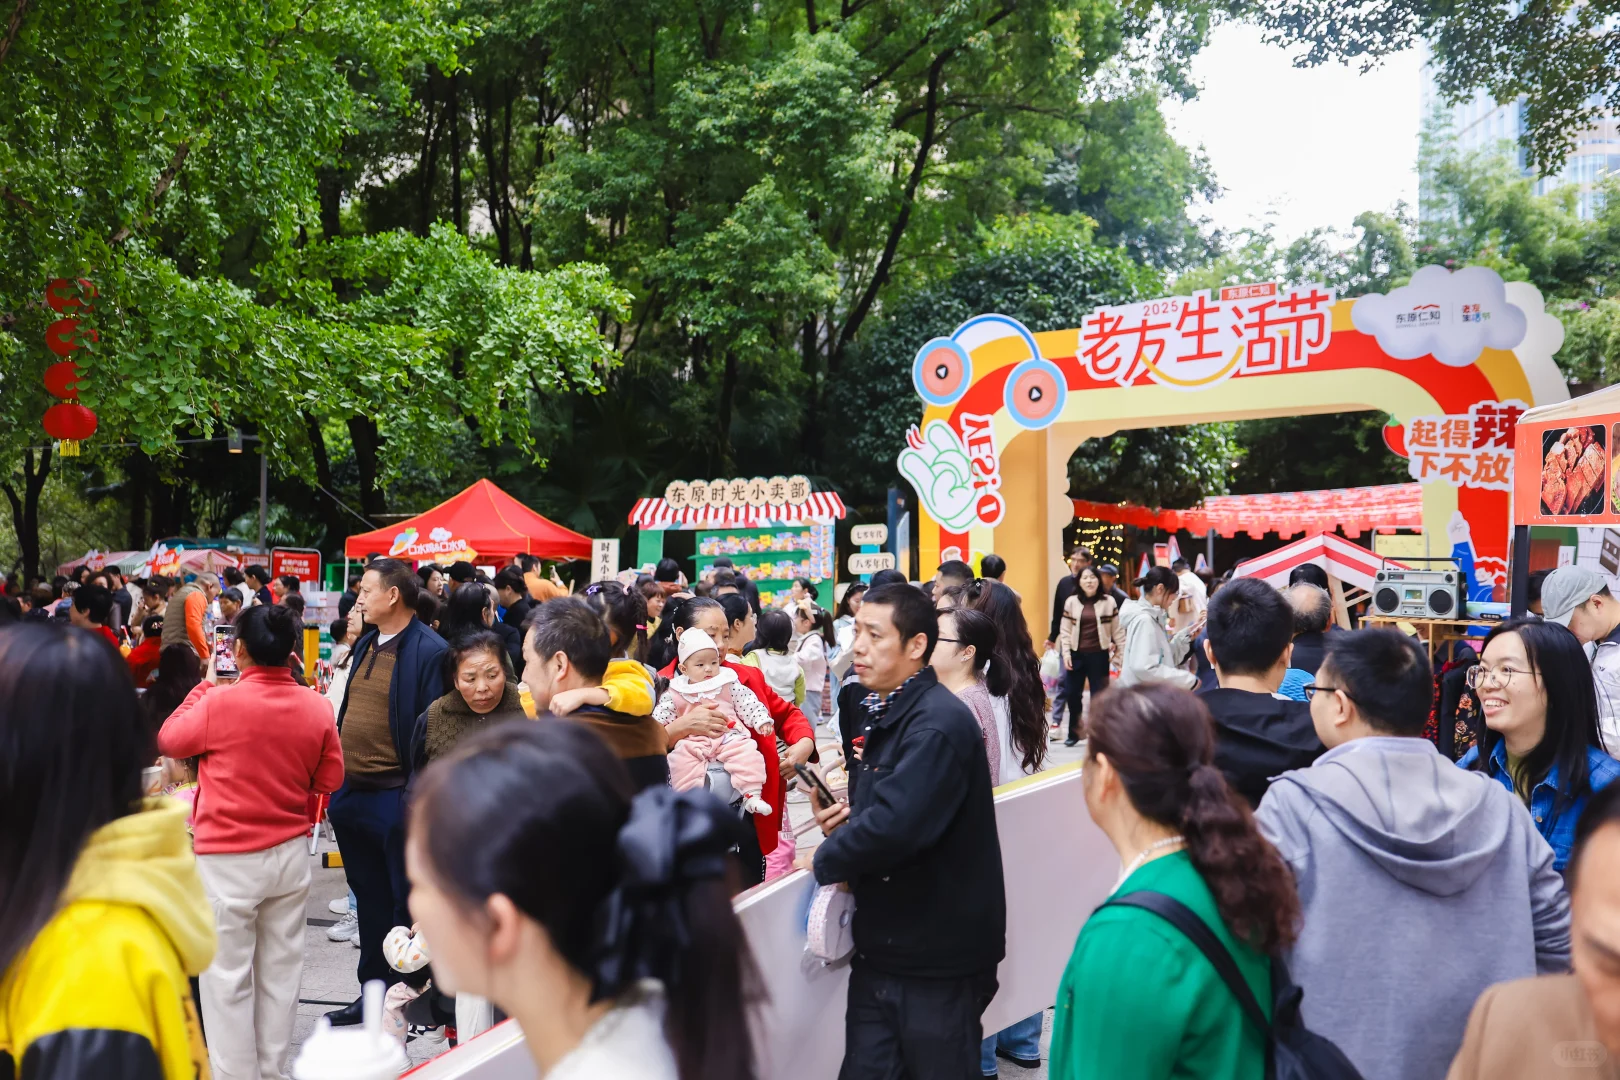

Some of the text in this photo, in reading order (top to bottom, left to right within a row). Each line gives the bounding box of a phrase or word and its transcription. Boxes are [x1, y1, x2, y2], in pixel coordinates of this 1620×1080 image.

[1143, 301, 1179, 317] 2025
[1396, 311, 1441, 324] 东原仁知
[1082, 289, 1330, 381] 老友生活节
[1409, 404, 1525, 449] 起得辣
[1414, 451, 1511, 484] 下不放
[671, 481, 805, 503] 东原时光小卖部
[856, 530, 883, 540] 七零年代
[855, 558, 890, 569] 八零年代
